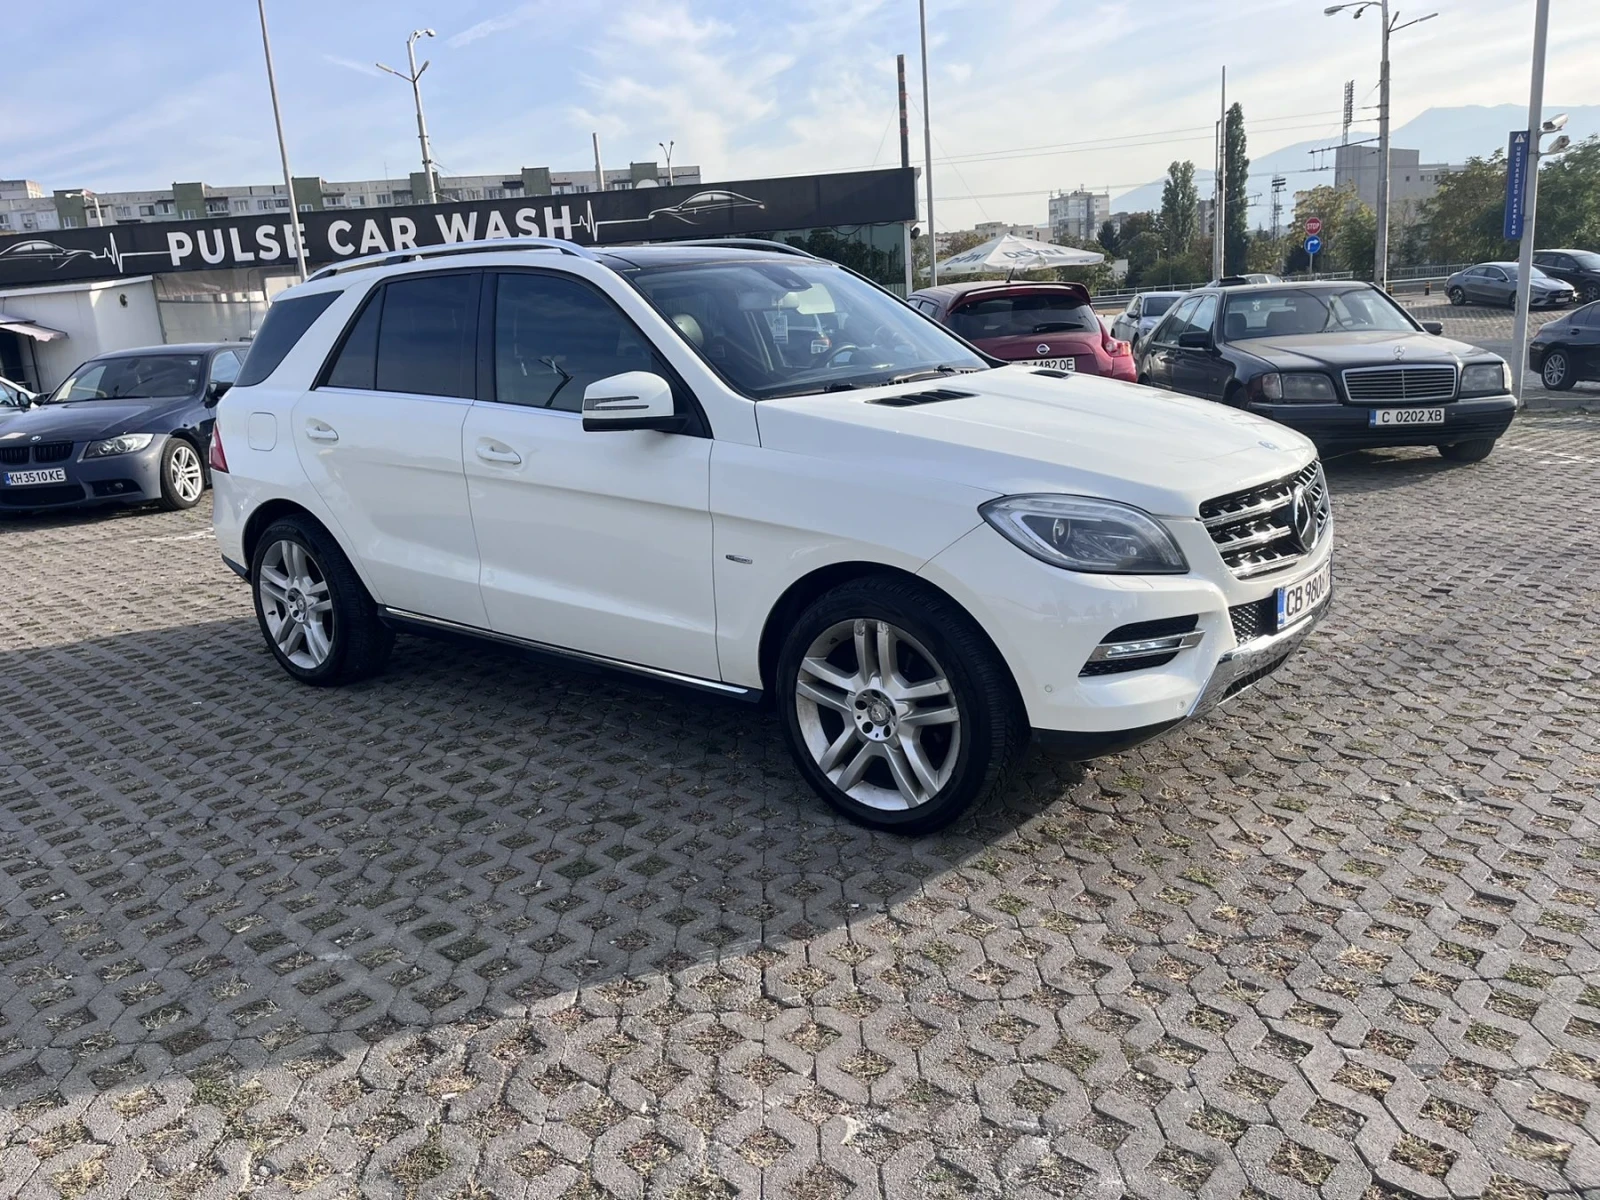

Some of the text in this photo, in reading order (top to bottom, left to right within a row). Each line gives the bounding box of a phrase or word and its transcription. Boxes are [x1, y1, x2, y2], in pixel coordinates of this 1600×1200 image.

[1513, 146, 1521, 194] UNGUARDED
[166, 205, 573, 266] PULSE CAR WASH
[1306, 222, 1320, 230] STOP
[1395, 410, 1425, 422] 0202
[1286, 585, 1303, 616] CB
